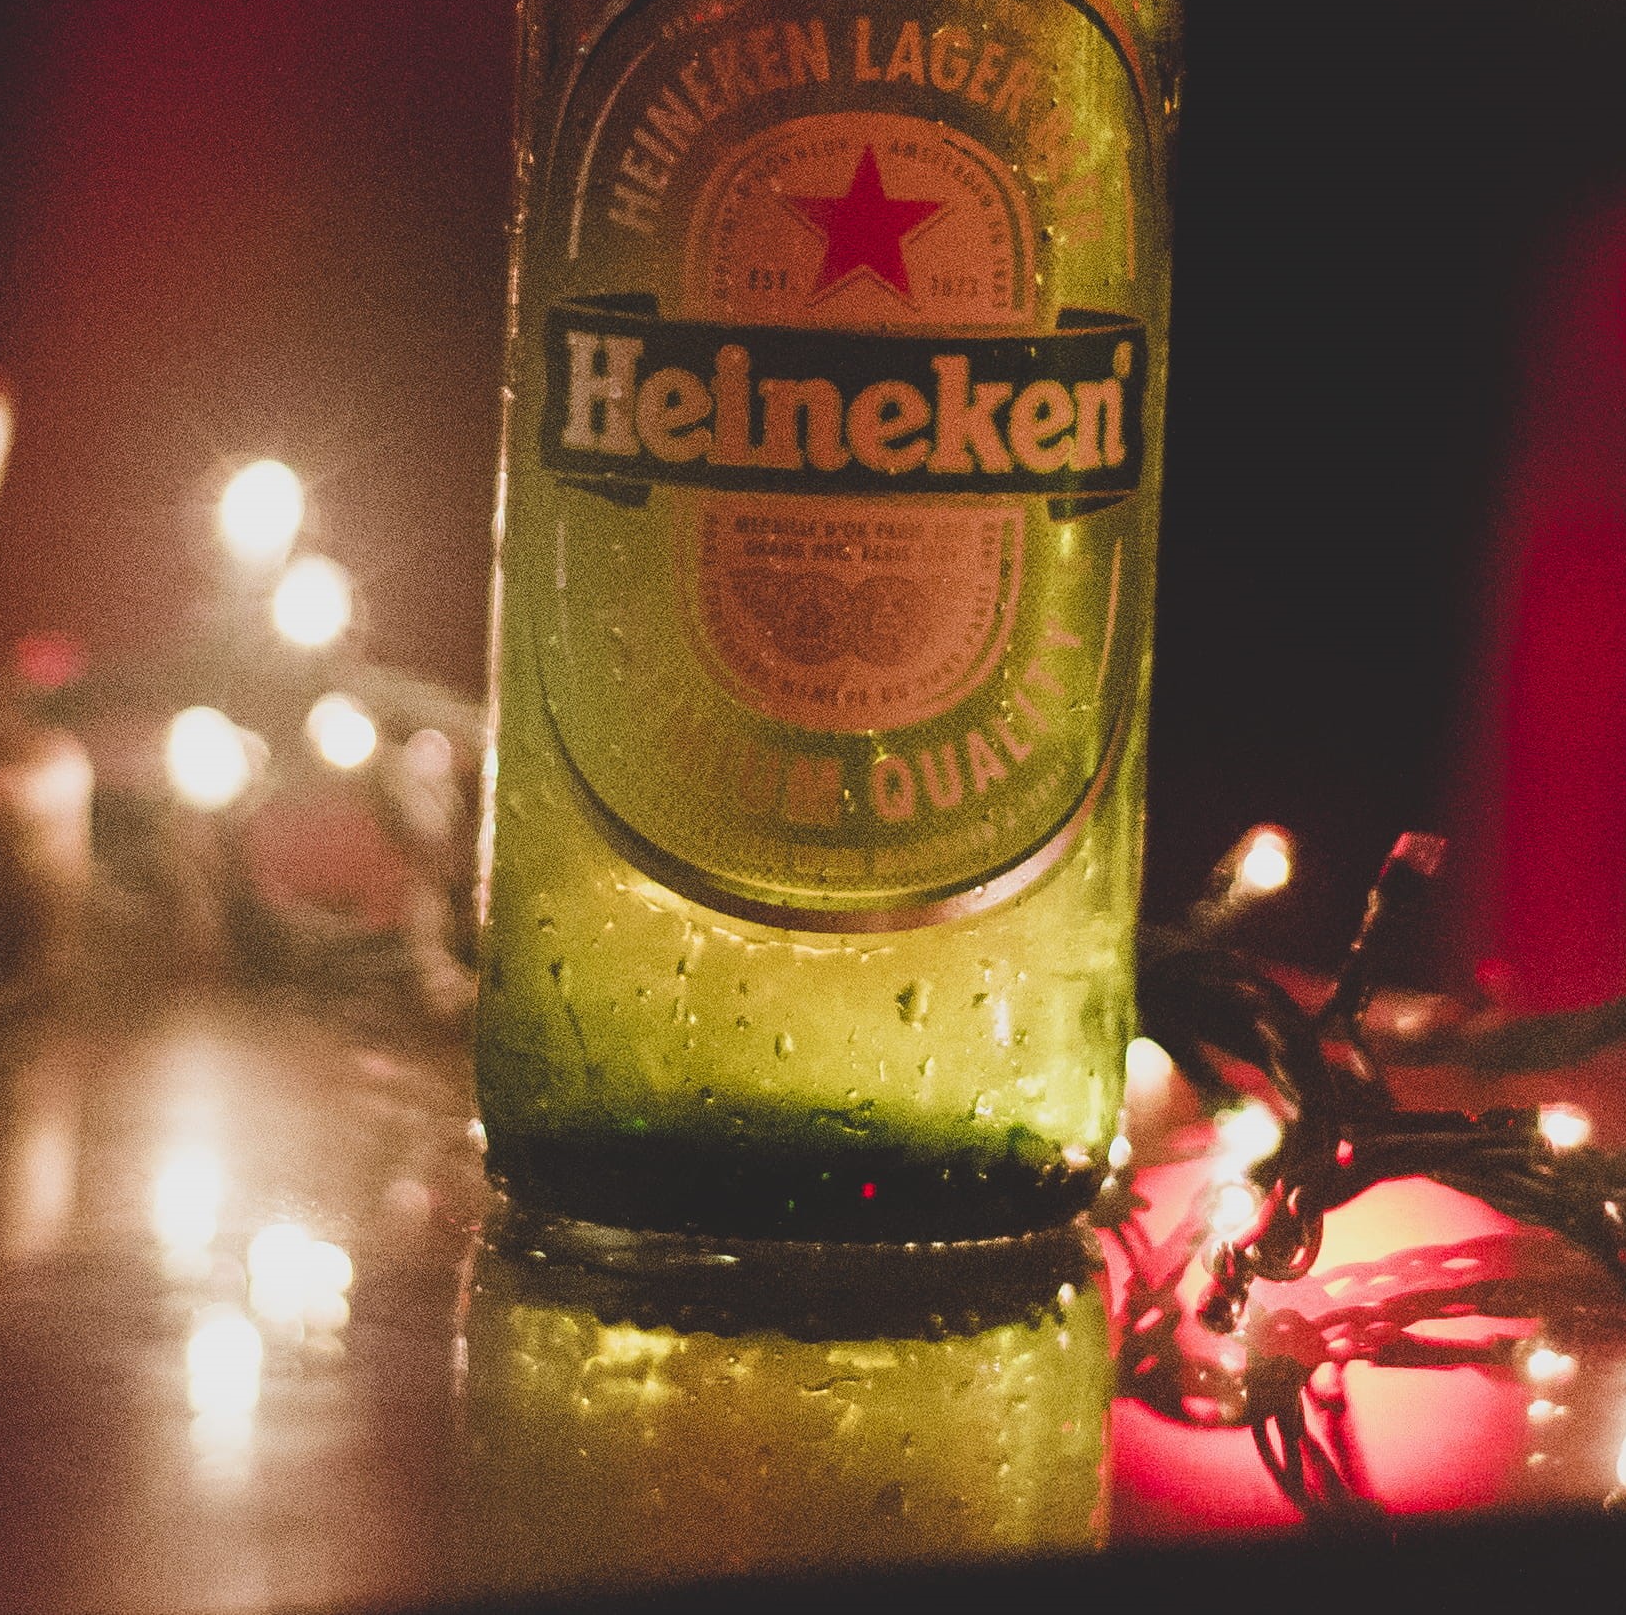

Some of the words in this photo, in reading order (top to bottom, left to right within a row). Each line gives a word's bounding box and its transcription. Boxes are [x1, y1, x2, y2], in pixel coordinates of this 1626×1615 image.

[607, 15, 830, 236] HEINEKEN
[855, 15, 1037, 125] LAGER
[561, 331, 1129, 475] Heineken
[871, 616, 1083, 821] QUALITY
